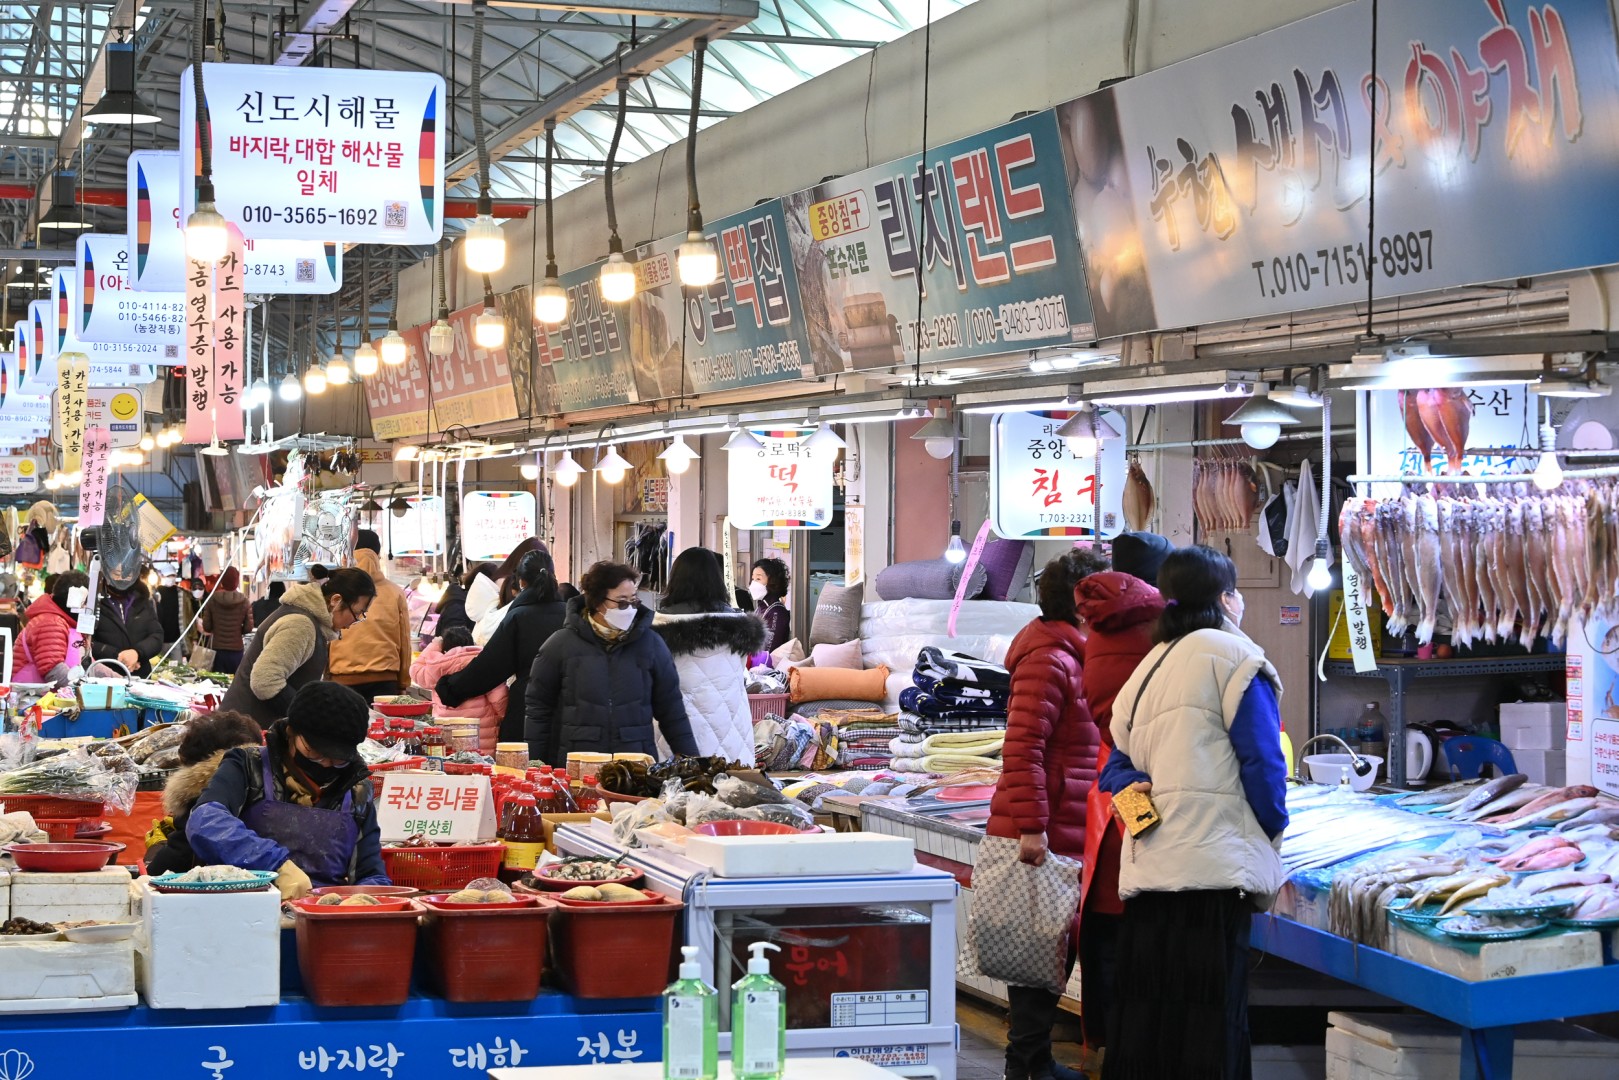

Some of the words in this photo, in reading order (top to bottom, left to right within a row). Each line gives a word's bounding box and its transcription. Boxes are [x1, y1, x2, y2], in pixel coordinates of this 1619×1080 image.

[236, 90, 400, 129] 신도시해물
[229, 135, 335, 166] 바지락,대합
[341, 139, 405, 168] 해산물
[296, 169, 338, 196] 일체
[242, 205, 378, 226] 010-3565-1692
[816, 200, 863, 237] 중앙침구
[873, 133, 1057, 299] 리치랜드
[220, 251, 240, 291] 카드
[1252, 229, 1435, 300] T.010-7151-8997
[189, 293, 210, 356] 영수증
[217, 305, 240, 350] 사용
[93, 342, 158, 353] 010-3156-2024
[73, 370, 86, 393] 카드
[190, 364, 209, 411] 발행
[218, 361, 239, 404] 가능
[71, 398, 85, 422] 사용
[69, 428, 82, 453] 가능
[83, 459, 93, 488] 영수증
[95, 466, 105, 485] 사용
[768, 463, 799, 495] 떡
[92, 490, 103, 512] 가능
[1039, 513, 1093, 523] T.703-2321
[1352, 620, 1368, 651] 발행
[387, 786, 423, 810] 국산
[426, 786, 480, 811] 콩나물
[402, 819, 453, 836] 의령상회
[785, 945, 850, 987] 문어
[298, 1042, 405, 1079] 바지락
